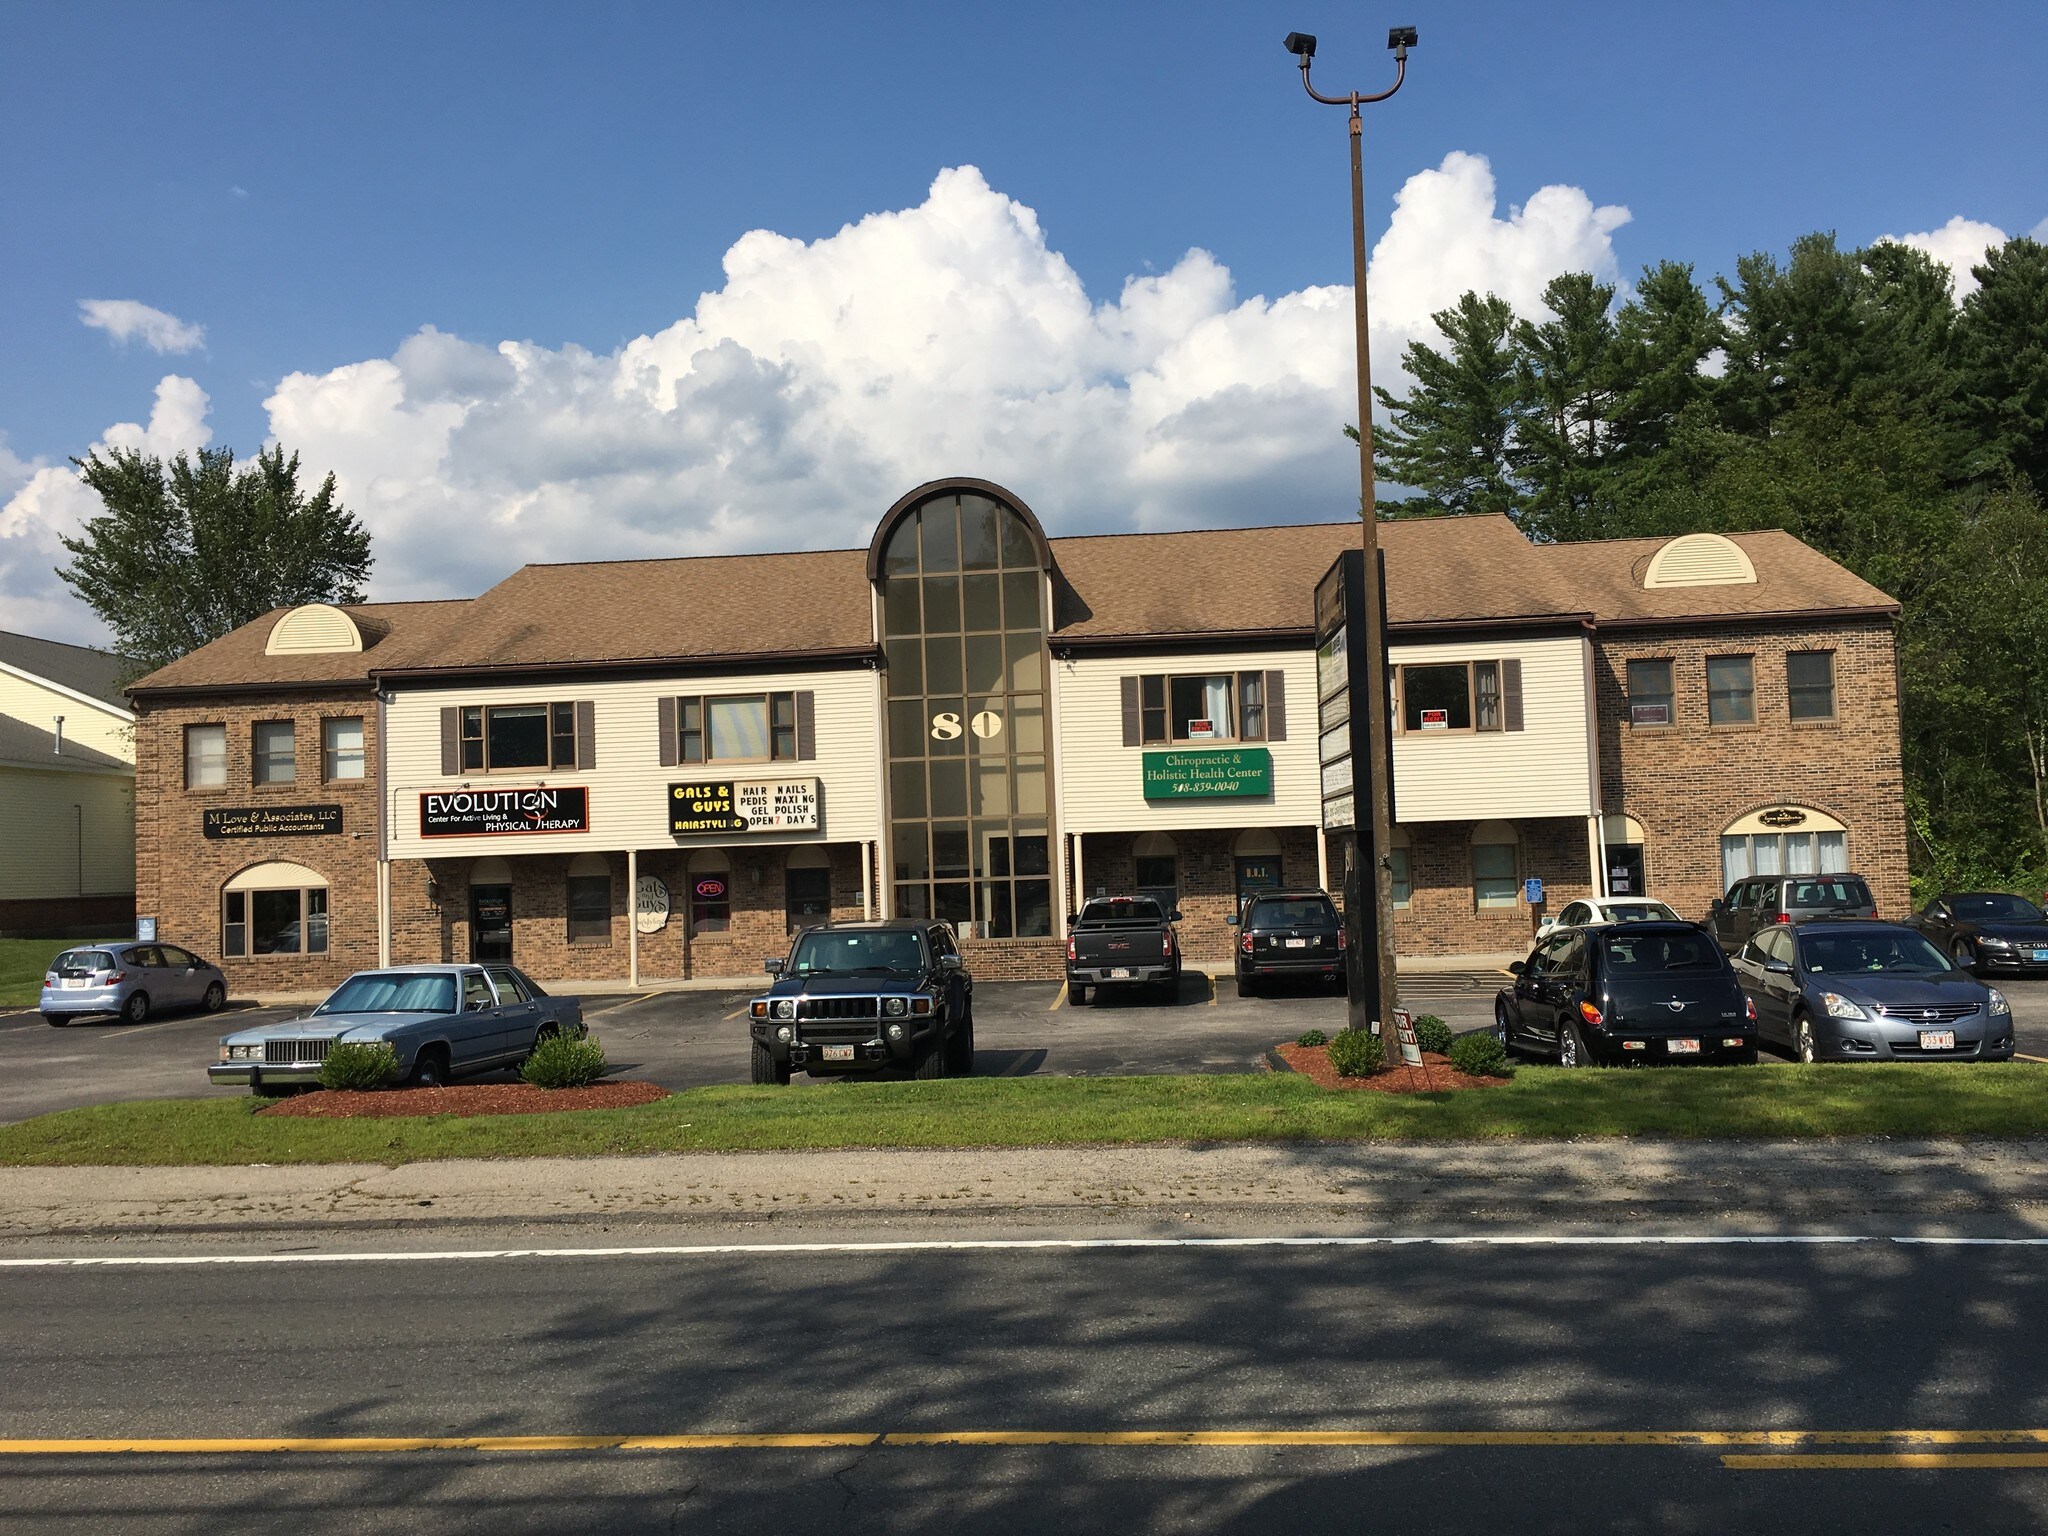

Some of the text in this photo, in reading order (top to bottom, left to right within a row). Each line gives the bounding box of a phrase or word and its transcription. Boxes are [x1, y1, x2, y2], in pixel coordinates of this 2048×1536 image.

[931, 711, 1002, 740] 80
[1166, 754, 1242, 767] Chiropractic &
[1147, 767, 1262, 780] Holistic Health Center
[674, 786, 729, 799] GALS &
[743, 785, 807, 796] HAIR NAILS
[427, 791, 557, 813] EVOLUTION
[692, 800, 730, 813] GUYS
[740, 796, 768, 806] PEDIS
[751, 805, 809, 815] GEL POLISH
[208, 811, 337, 824] M Love & Associates, LLC
[428, 815, 449, 823] Center
[462, 814, 482, 822] Active
[482, 814, 501, 822] Living
[749, 816, 774, 826] OPEN
[775, 816, 781, 825] 7
[220, 823, 325, 834] Certified Public Accountants
[486, 821, 532, 831] PHYSICAL
[675, 818, 743, 830] HAIRSTYLIG
[700, 883, 721, 893] OPEN
[1922, 1035, 1937, 1045] 733
